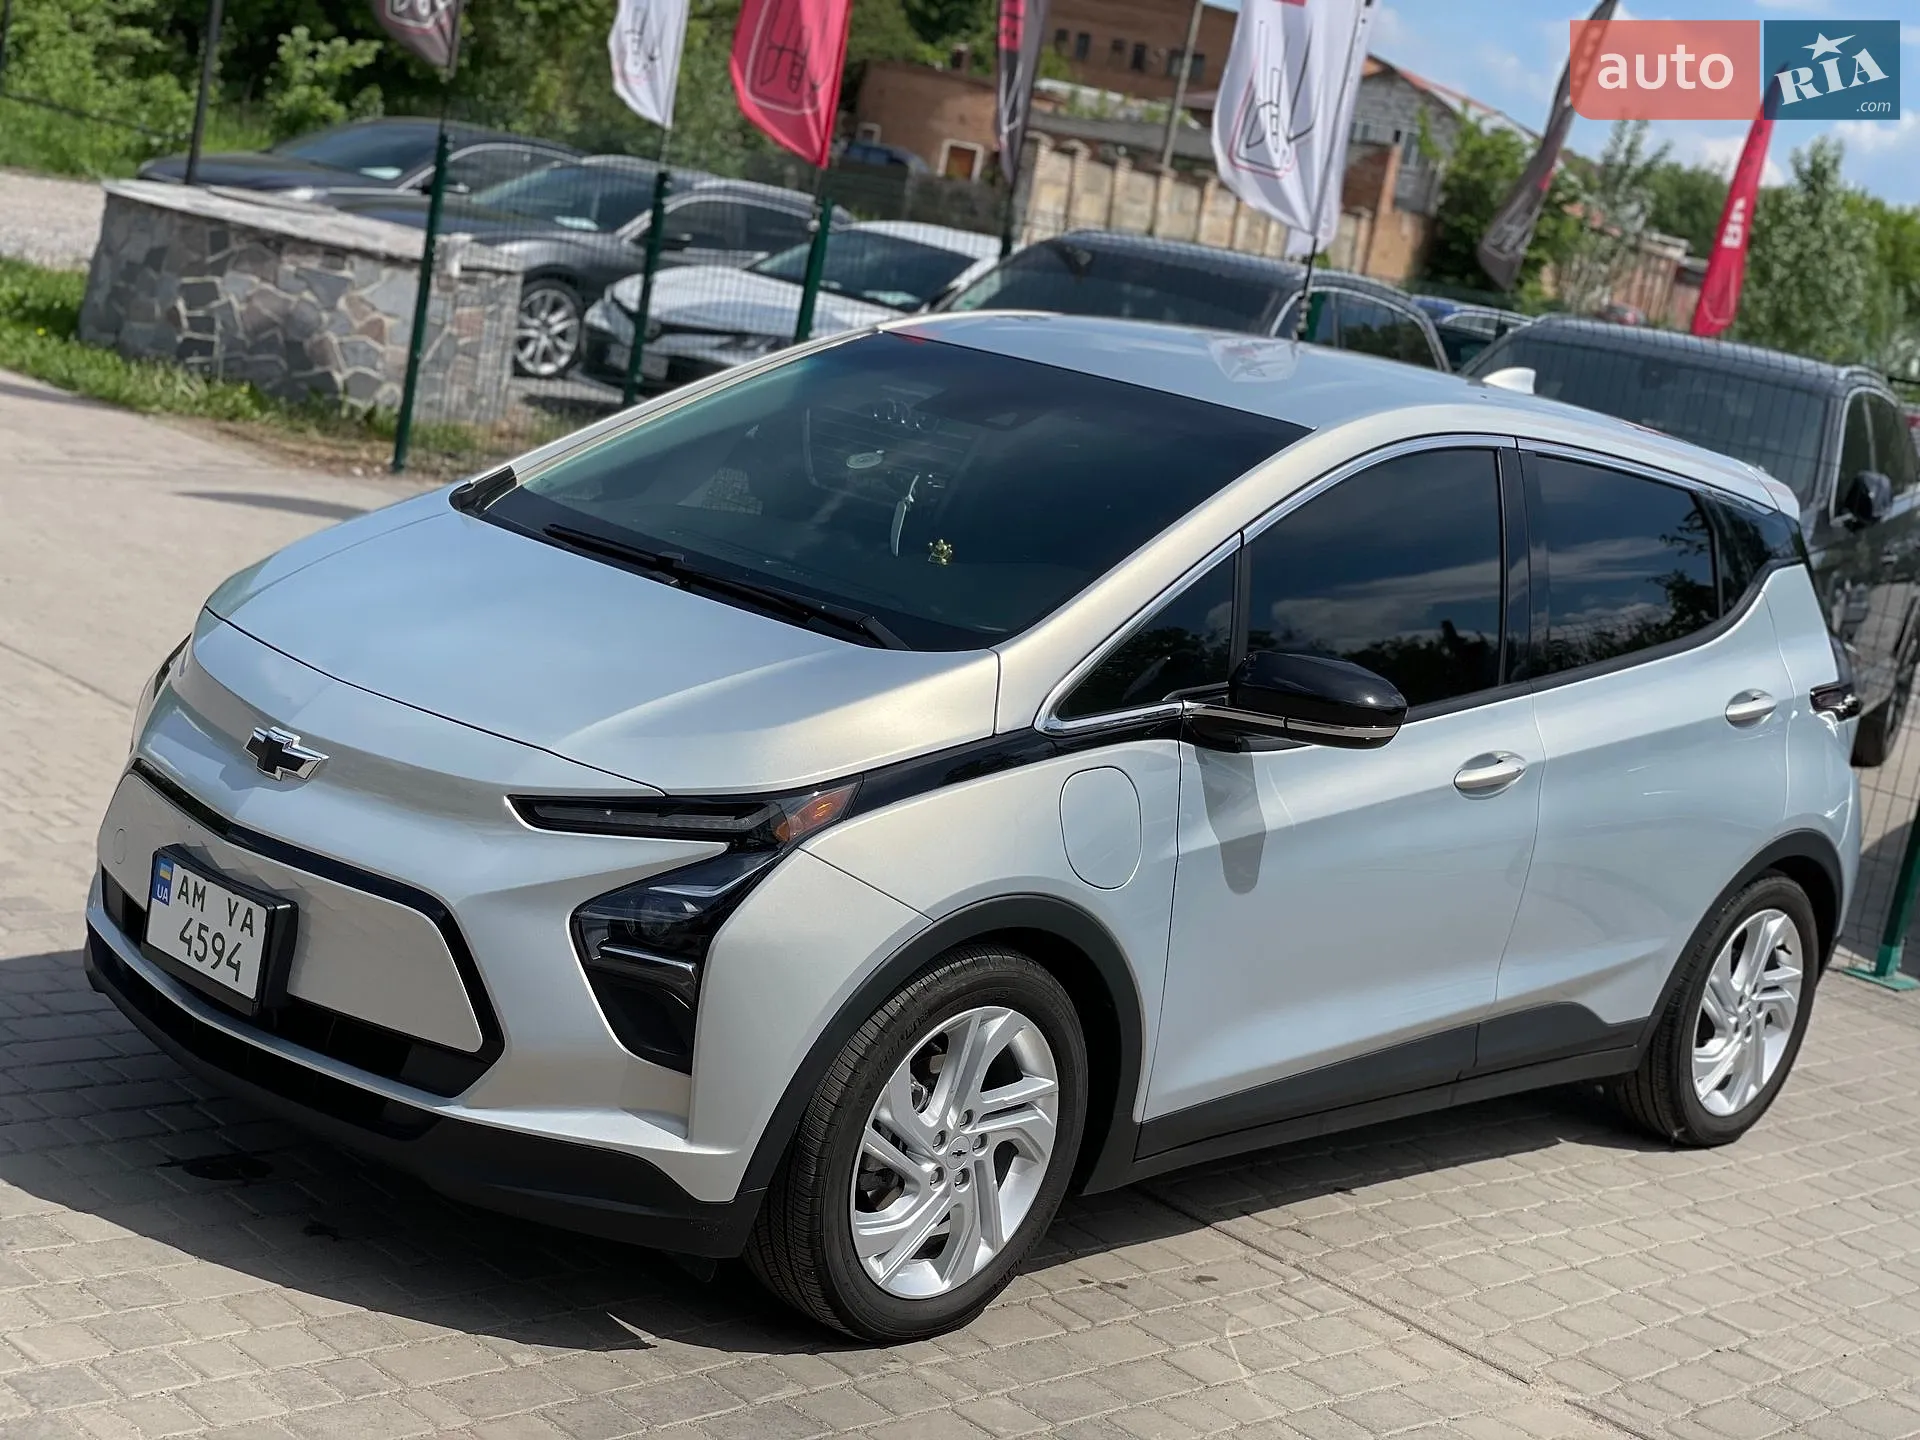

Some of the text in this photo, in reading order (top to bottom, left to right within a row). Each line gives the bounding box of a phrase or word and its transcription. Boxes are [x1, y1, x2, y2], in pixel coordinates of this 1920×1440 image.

[157, 883, 168, 902] UA
[177, 875, 254, 937] AM YA
[179, 917, 242, 982] 4594
